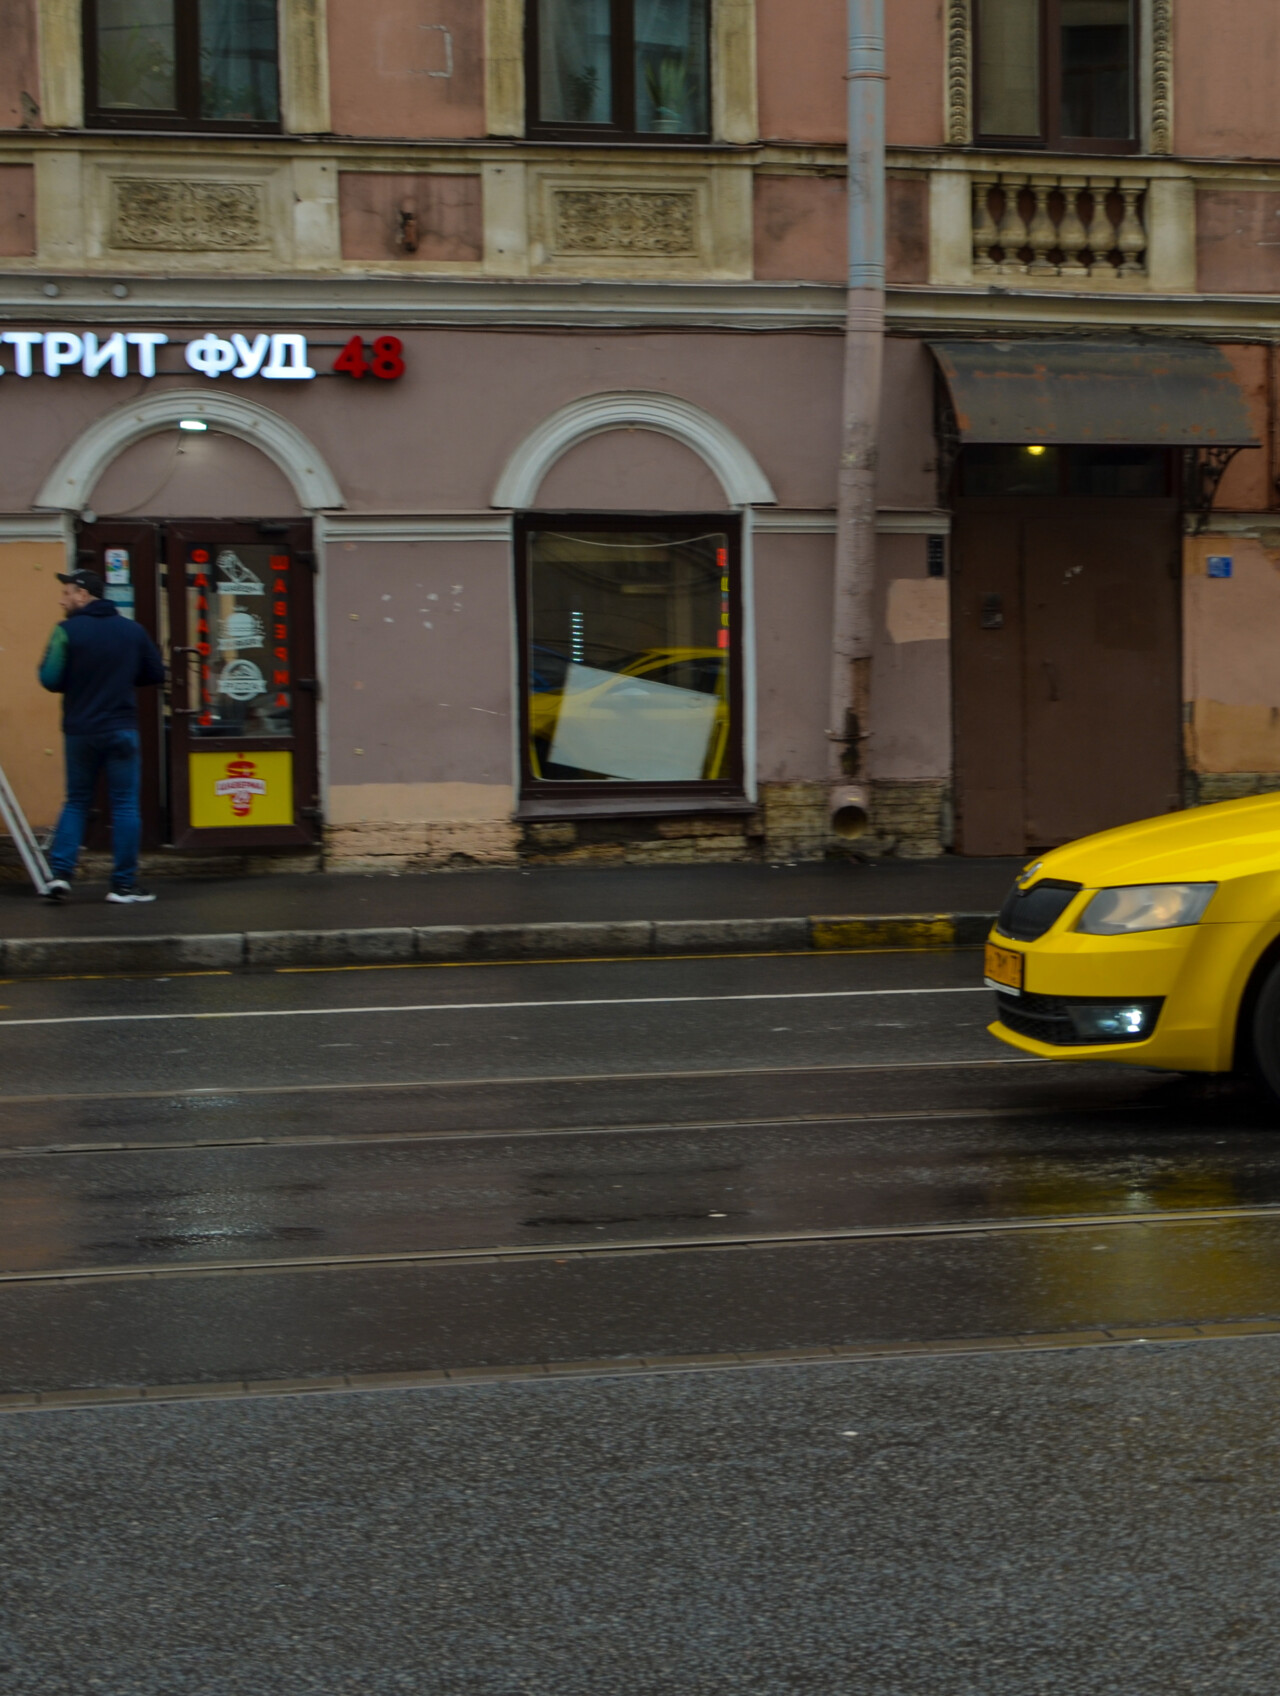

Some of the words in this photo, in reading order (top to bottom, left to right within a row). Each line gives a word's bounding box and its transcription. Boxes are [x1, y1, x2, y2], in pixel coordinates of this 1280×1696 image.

[0, 332, 168, 378] ТРИТ
[184, 333, 316, 379] ФУД
[332, 335, 405, 379] 48
